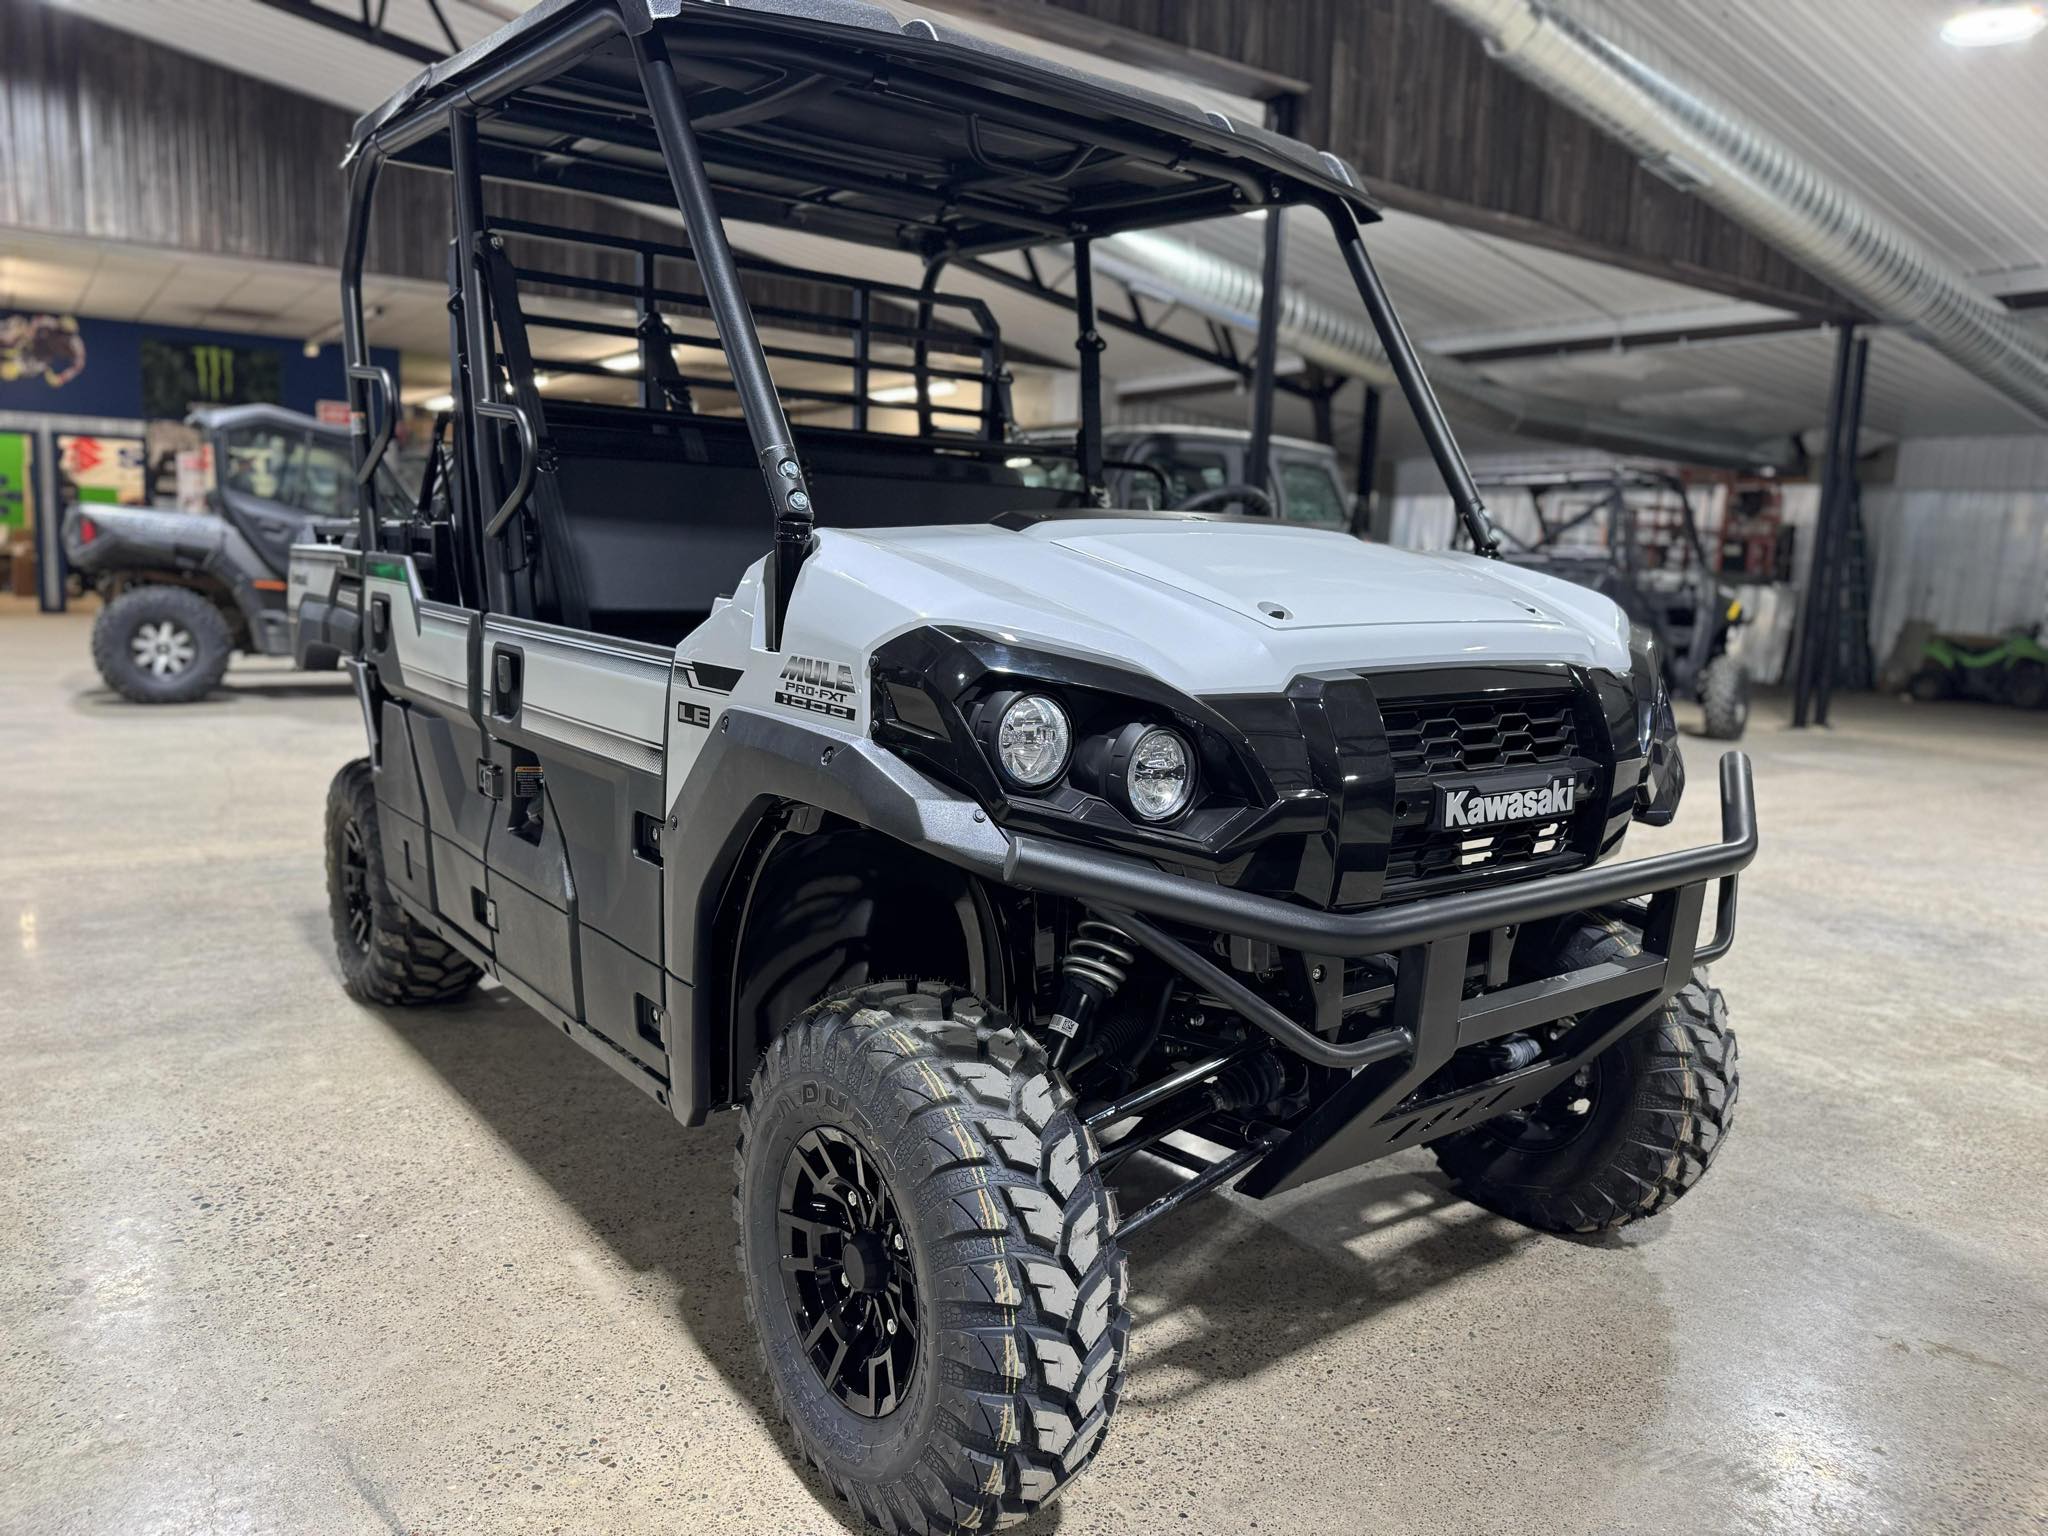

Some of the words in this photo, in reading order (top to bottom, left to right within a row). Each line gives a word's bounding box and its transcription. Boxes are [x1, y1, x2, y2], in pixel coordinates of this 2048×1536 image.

[779, 655, 857, 694] MULE
[679, 704, 709, 725] LE
[781, 693, 848, 718] 1000
[1445, 778, 1575, 828] Kawasaki
